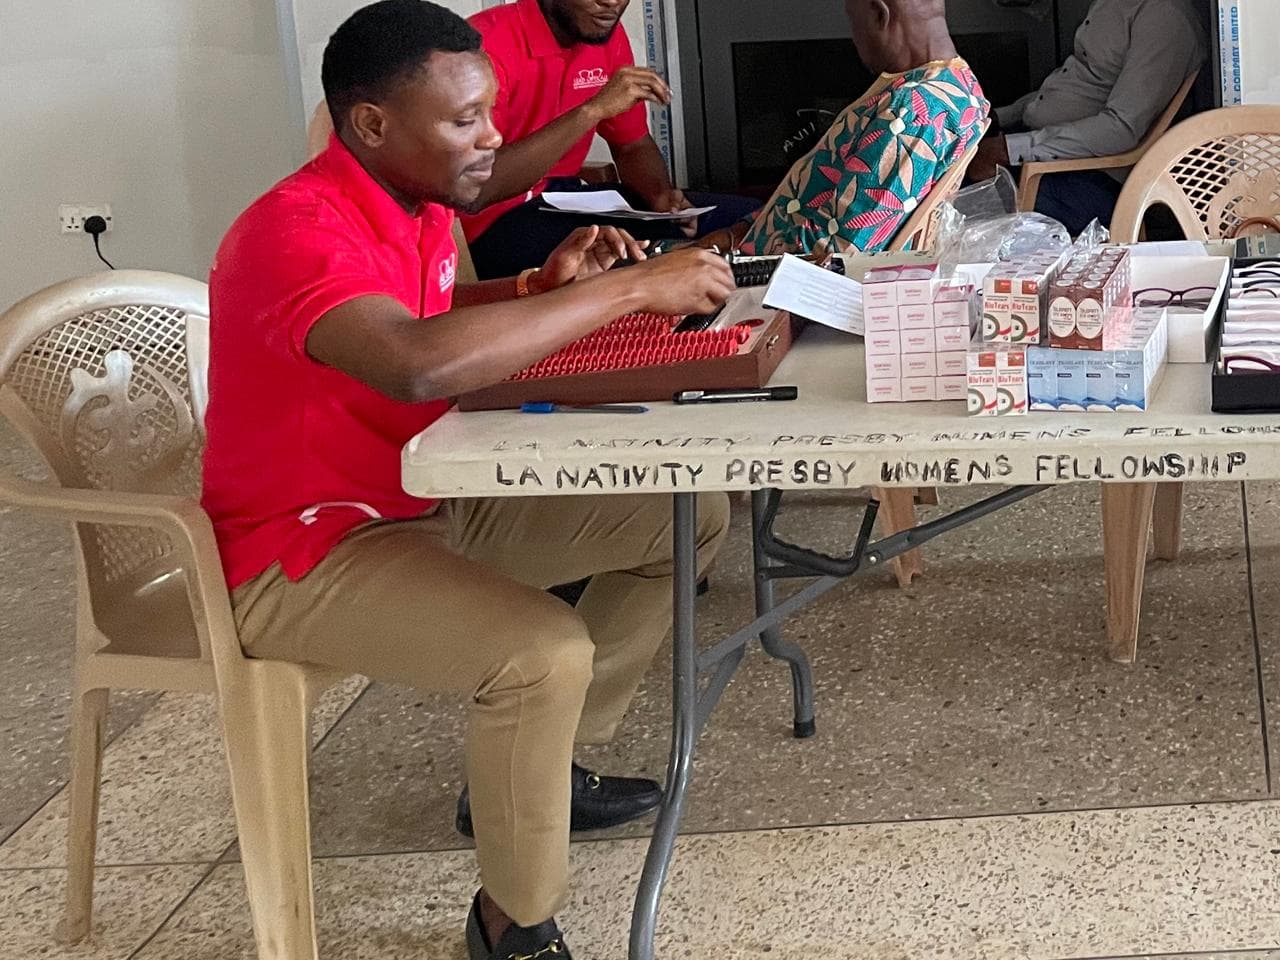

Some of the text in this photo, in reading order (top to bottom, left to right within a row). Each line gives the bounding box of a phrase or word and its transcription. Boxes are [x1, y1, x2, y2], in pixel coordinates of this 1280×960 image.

[1230, 6, 1239, 41] LIMITED
[1231, 47, 1242, 92] COMPANY
[495, 461, 544, 487] LA
[555, 461, 705, 489] NATIVITY
[724, 457, 857, 486] PRESBY
[1035, 451, 1248, 482] FELLOWSHIP
